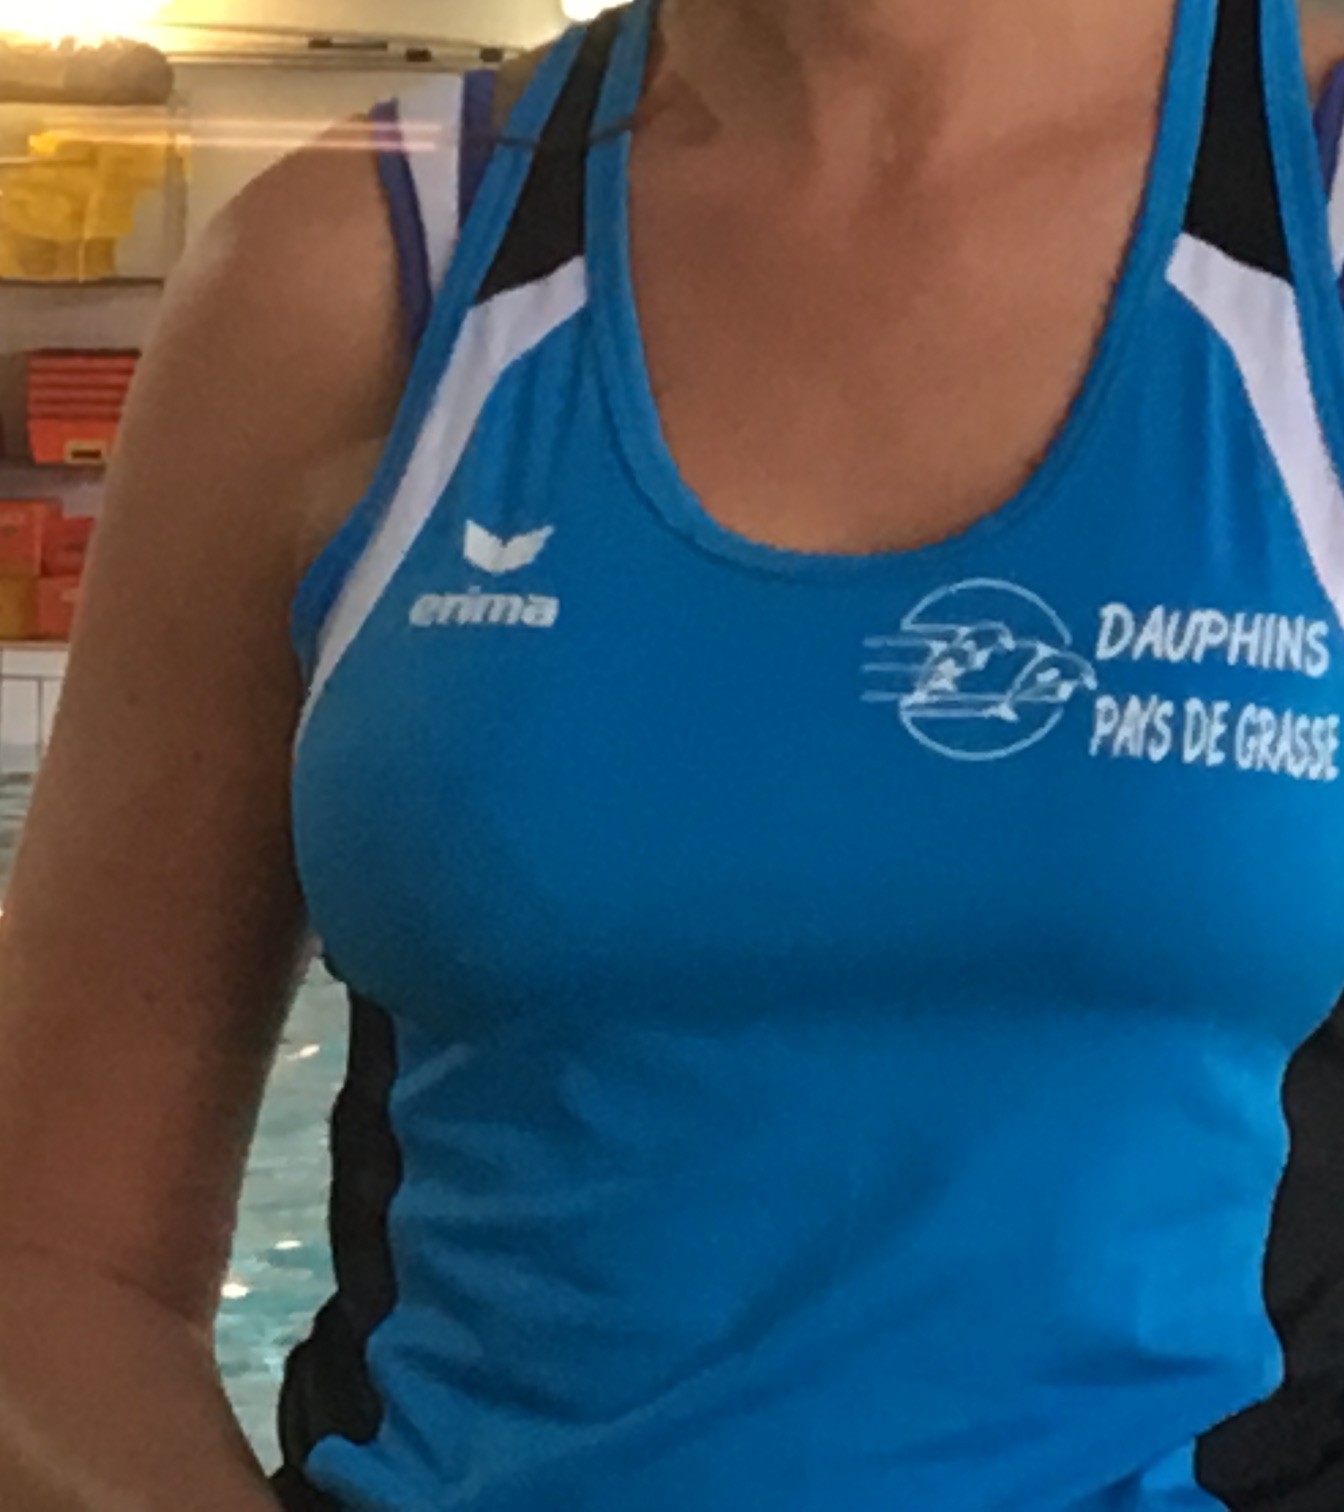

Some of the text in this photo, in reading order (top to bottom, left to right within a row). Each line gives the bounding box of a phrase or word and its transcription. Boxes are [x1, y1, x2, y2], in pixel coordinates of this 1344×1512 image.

[1095, 601, 1331, 678] DAUPHINS
[1088, 693, 1340, 781] PAYS DE GRASSE
